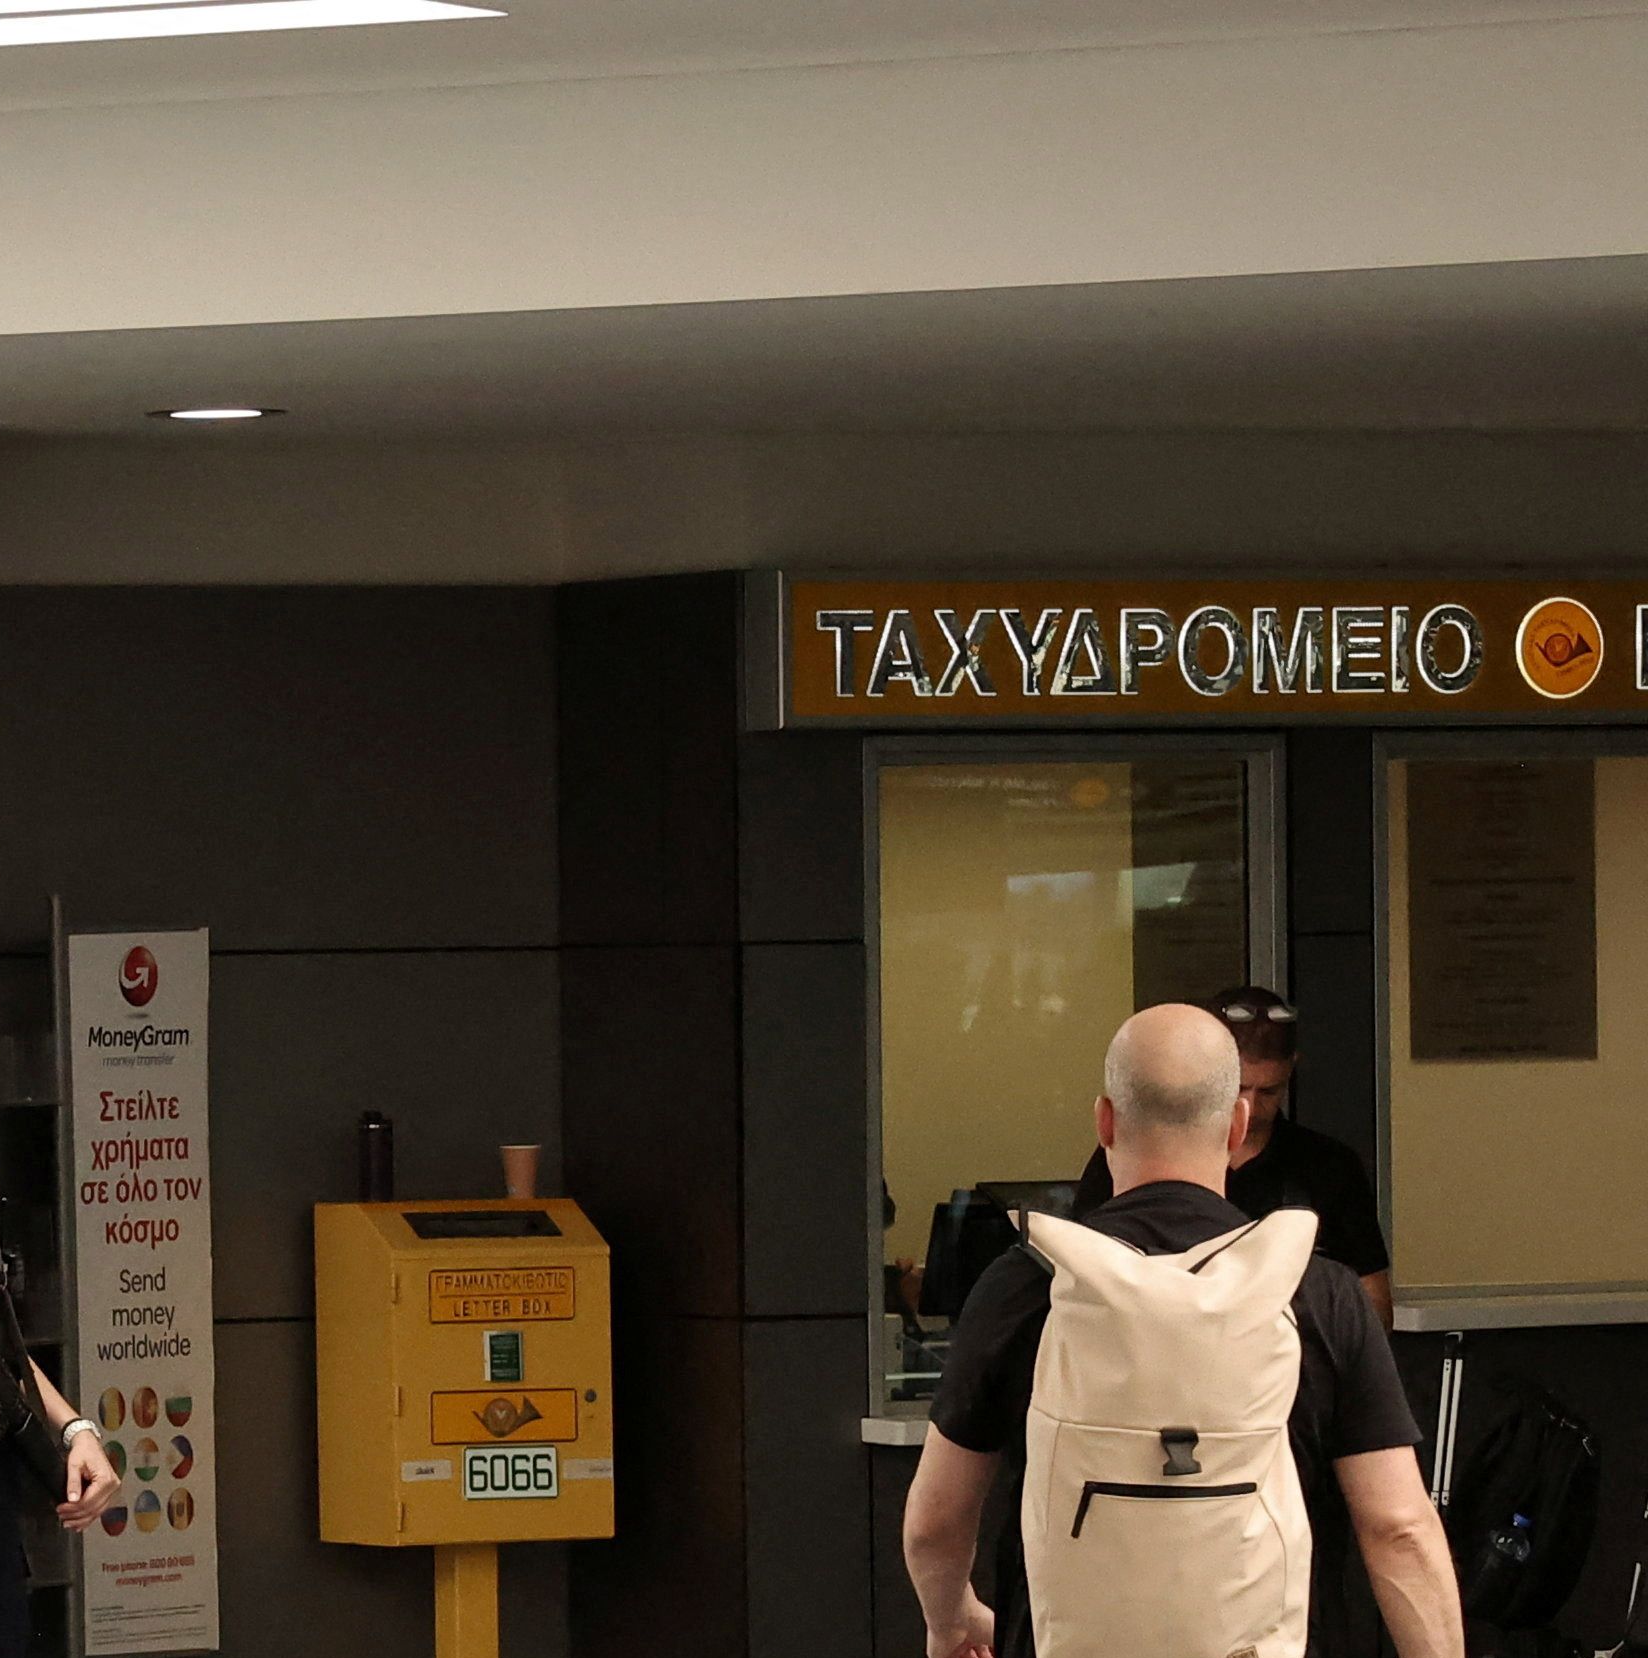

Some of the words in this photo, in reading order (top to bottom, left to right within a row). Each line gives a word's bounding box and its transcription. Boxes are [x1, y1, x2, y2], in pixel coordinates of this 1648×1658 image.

[814, 603, 1484, 698] ΤΑΧΥΔΡΟΜΕΙΟ
[88, 1024, 190, 1054] MoneyGram
[99, 1089, 180, 1122] Στείλτε
[91, 1131, 190, 1171] χρήματα
[80, 1180, 109, 1205] σε
[115, 1172, 158, 1203] όλο
[163, 1177, 202, 1201] τον
[105, 1212, 180, 1251] κόσμο
[119, 1266, 166, 1294] Send
[112, 1305, 175, 1331] money
[453, 1299, 511, 1318] LETTER
[521, 1298, 552, 1316] BOX
[96, 1331, 191, 1361] worldwide
[468, 1453, 553, 1492] 6066
